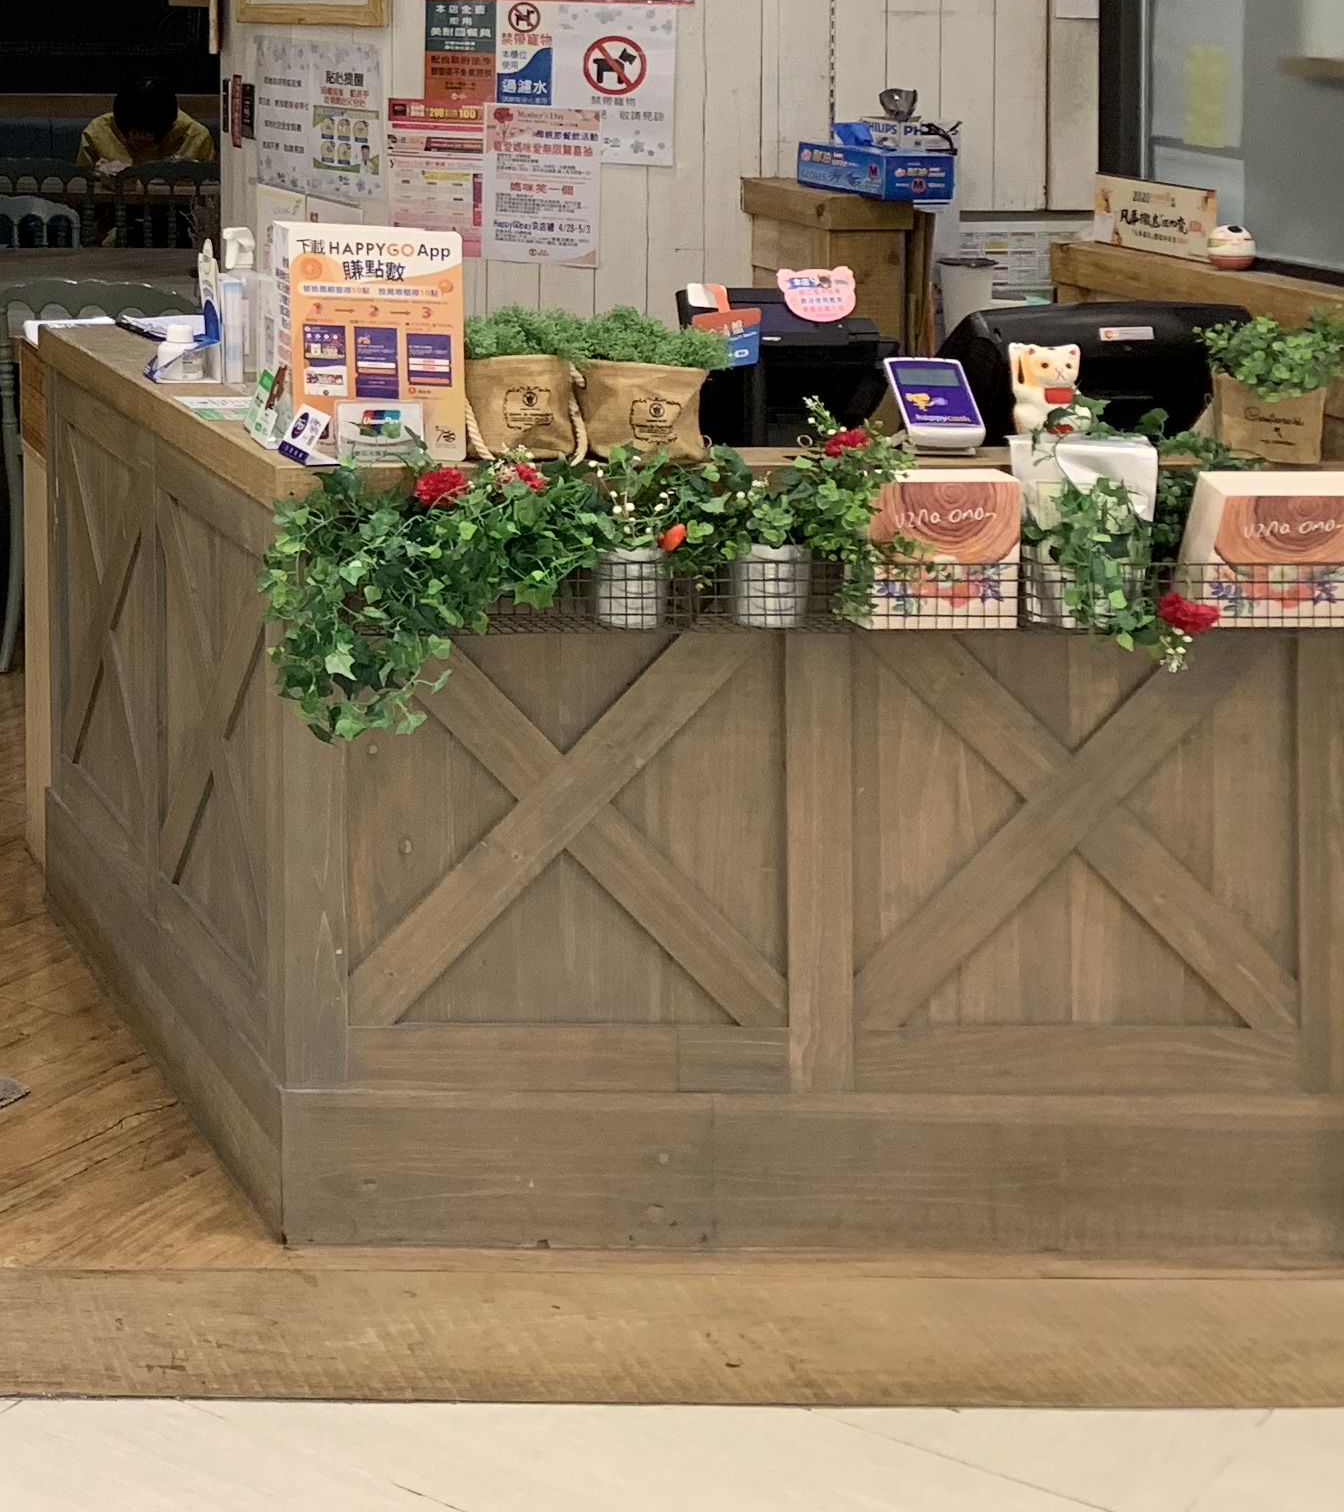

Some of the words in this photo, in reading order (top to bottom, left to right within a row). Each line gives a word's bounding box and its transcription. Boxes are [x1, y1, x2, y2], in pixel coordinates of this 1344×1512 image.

[329, 242, 415, 257] HAPPYGO
[417, 244, 451, 261] App
[343, 260, 406, 282] 賺點數
